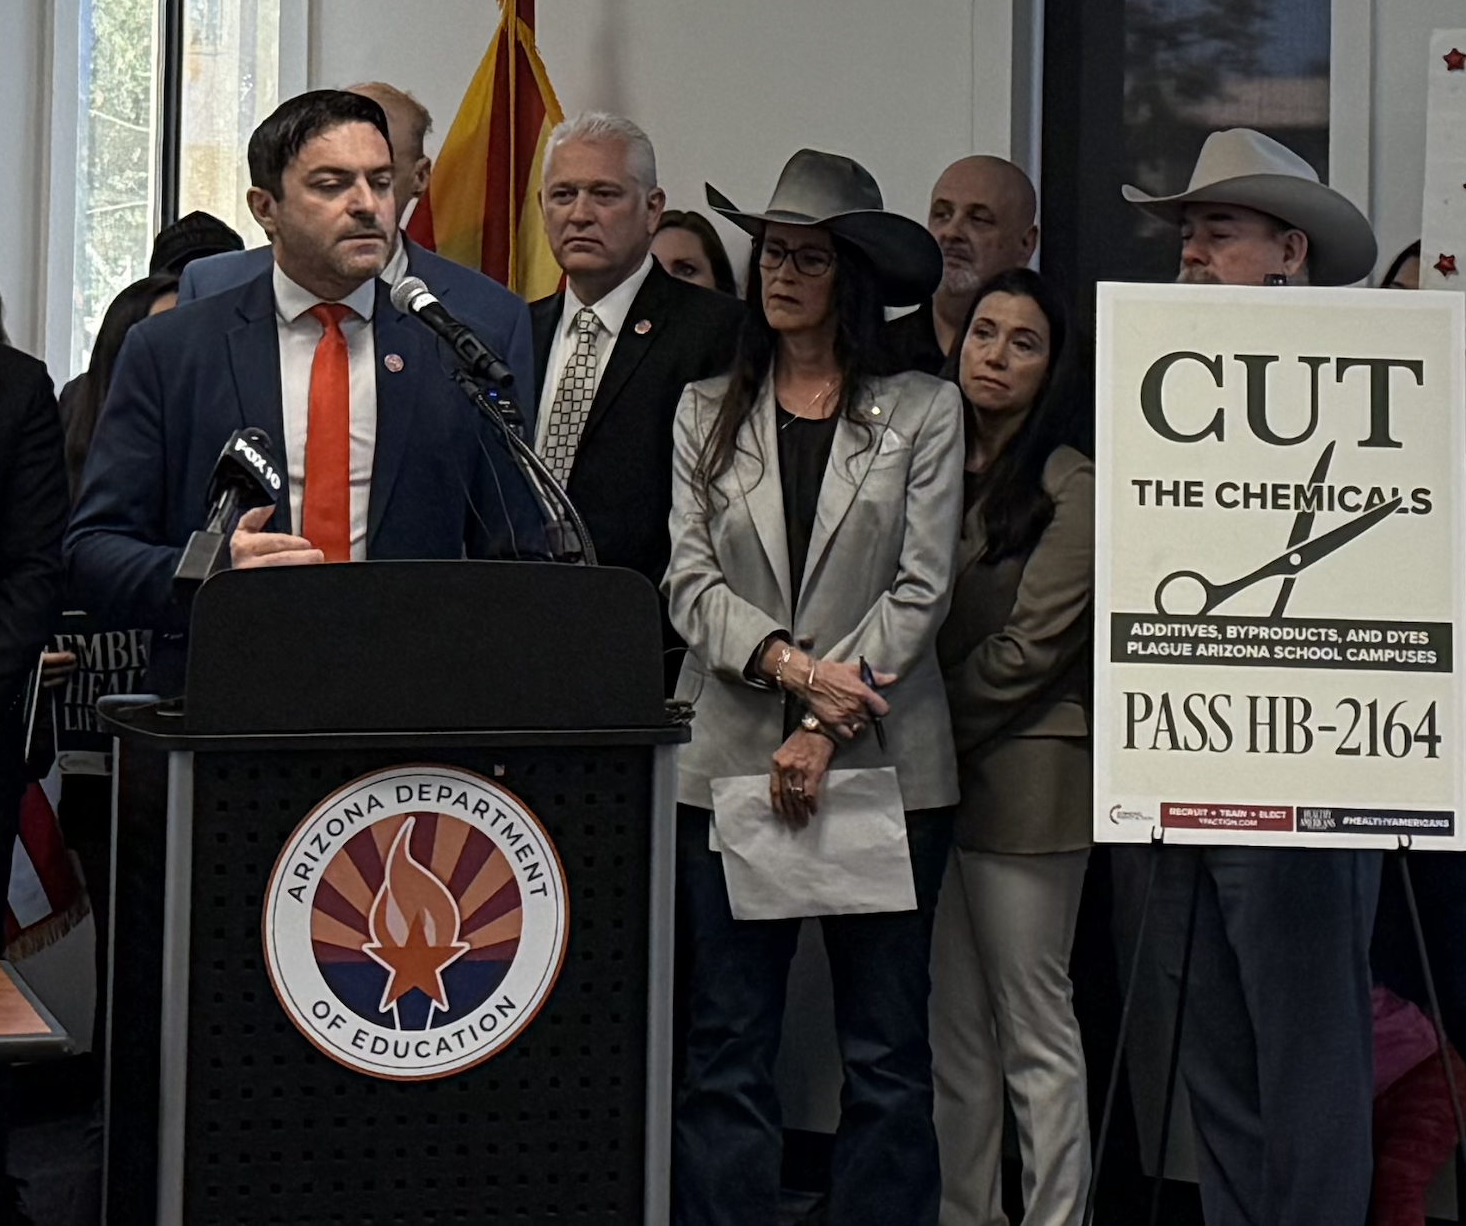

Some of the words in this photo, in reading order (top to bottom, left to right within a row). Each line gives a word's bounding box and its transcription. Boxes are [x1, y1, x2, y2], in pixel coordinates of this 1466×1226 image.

[1140, 351, 1424, 449] CUT
[234, 437, 267, 474] FOX
[265, 466, 281, 490] 10
[1131, 480, 1204, 508] THE
[1215, 481, 1432, 515] CHEMICALS
[1127, 641, 1192, 656] PLAGUE
[1196, 644, 1271, 659] ARIZONA
[1274, 646, 1343, 661] SCHOOL
[1346, 649, 1437, 664] CAMPUSES
[1131, 622, 1223, 640] ADDITIVES,
[1226, 625, 1342, 644] BYPRODUCTS,
[1346, 629, 1382, 643] AND
[1387, 630, 1429, 645] DYES
[1122, 691, 1233, 753] PASS
[1246, 694, 1441, 759] HB-2164
[1219, 809, 1246, 818] TRAIN
[1342, 816, 1450, 829] #HEALTHYAMERICANS
[286, 792, 384, 904] ARIZONA
[395, 782, 549, 899] DEPARTMENT
[312, 999, 346, 1032] OF
[350, 994, 518, 1060] EDUCATION
